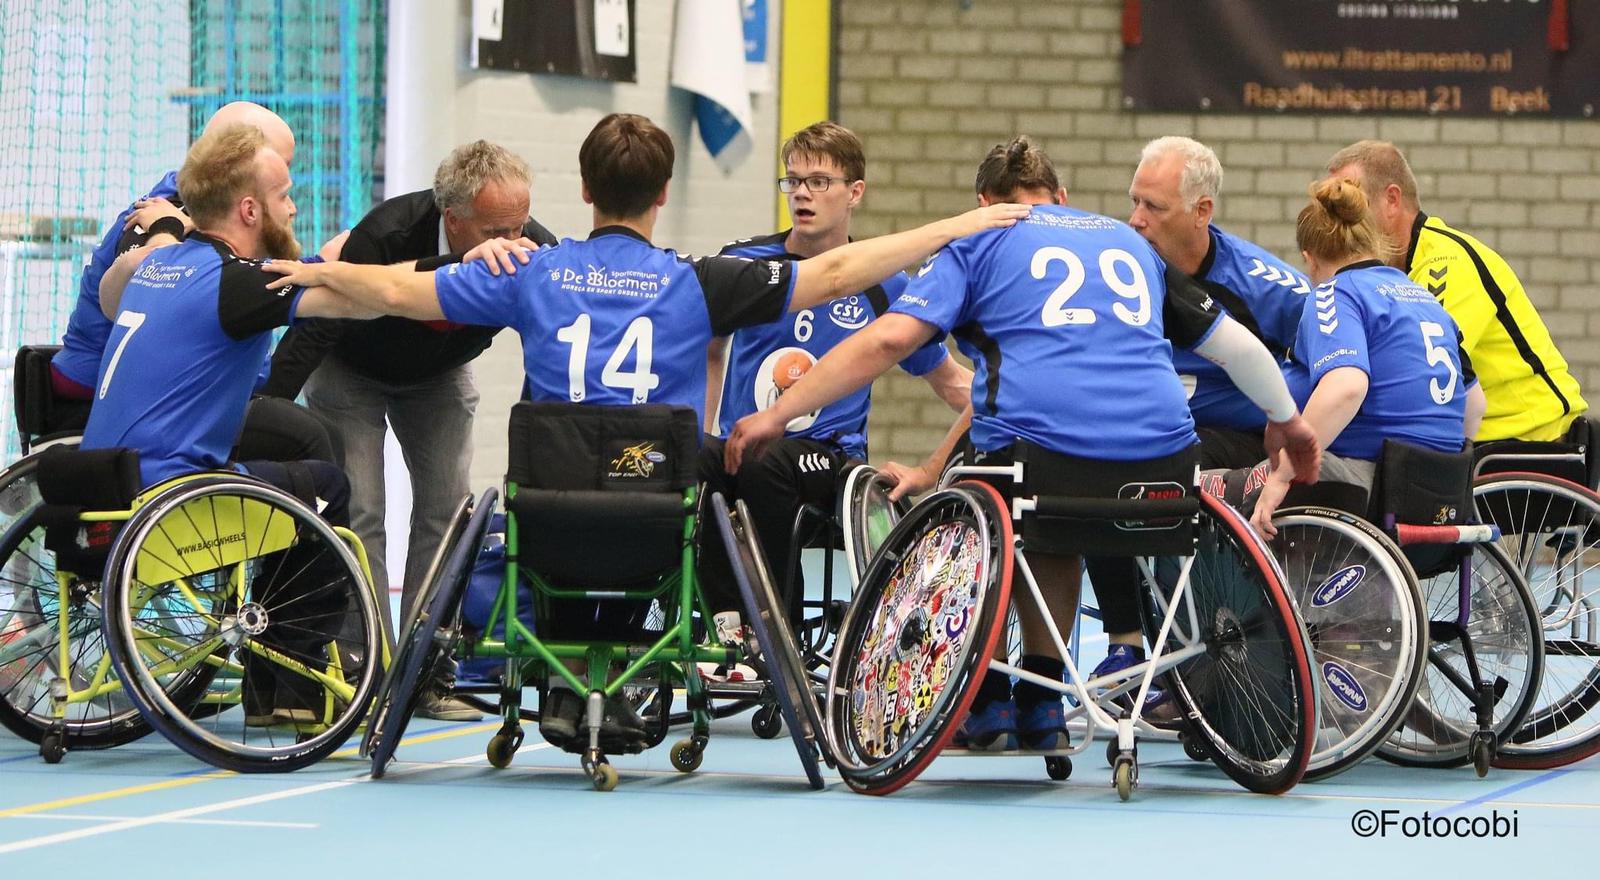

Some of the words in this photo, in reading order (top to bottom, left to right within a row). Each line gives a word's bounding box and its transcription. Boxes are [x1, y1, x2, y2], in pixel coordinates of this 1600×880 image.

[1243, 82, 1426, 109] Raadhuisstraat
[1434, 85, 1461, 110] 21
[1490, 85, 1550, 112] Beek
[563, 267, 584, 284] De
[586, 270, 658, 291] Bloemen
[611, 270, 658, 279] sportcentrum
[1030, 245, 1151, 328] 29
[794, 309, 815, 343] 6
[833, 303, 863, 318] CSV
[99, 310, 146, 399] 7
[557, 313, 660, 405] 14
[1420, 321, 1458, 405] 5
[1326, 671, 1365, 706] INVACARE
